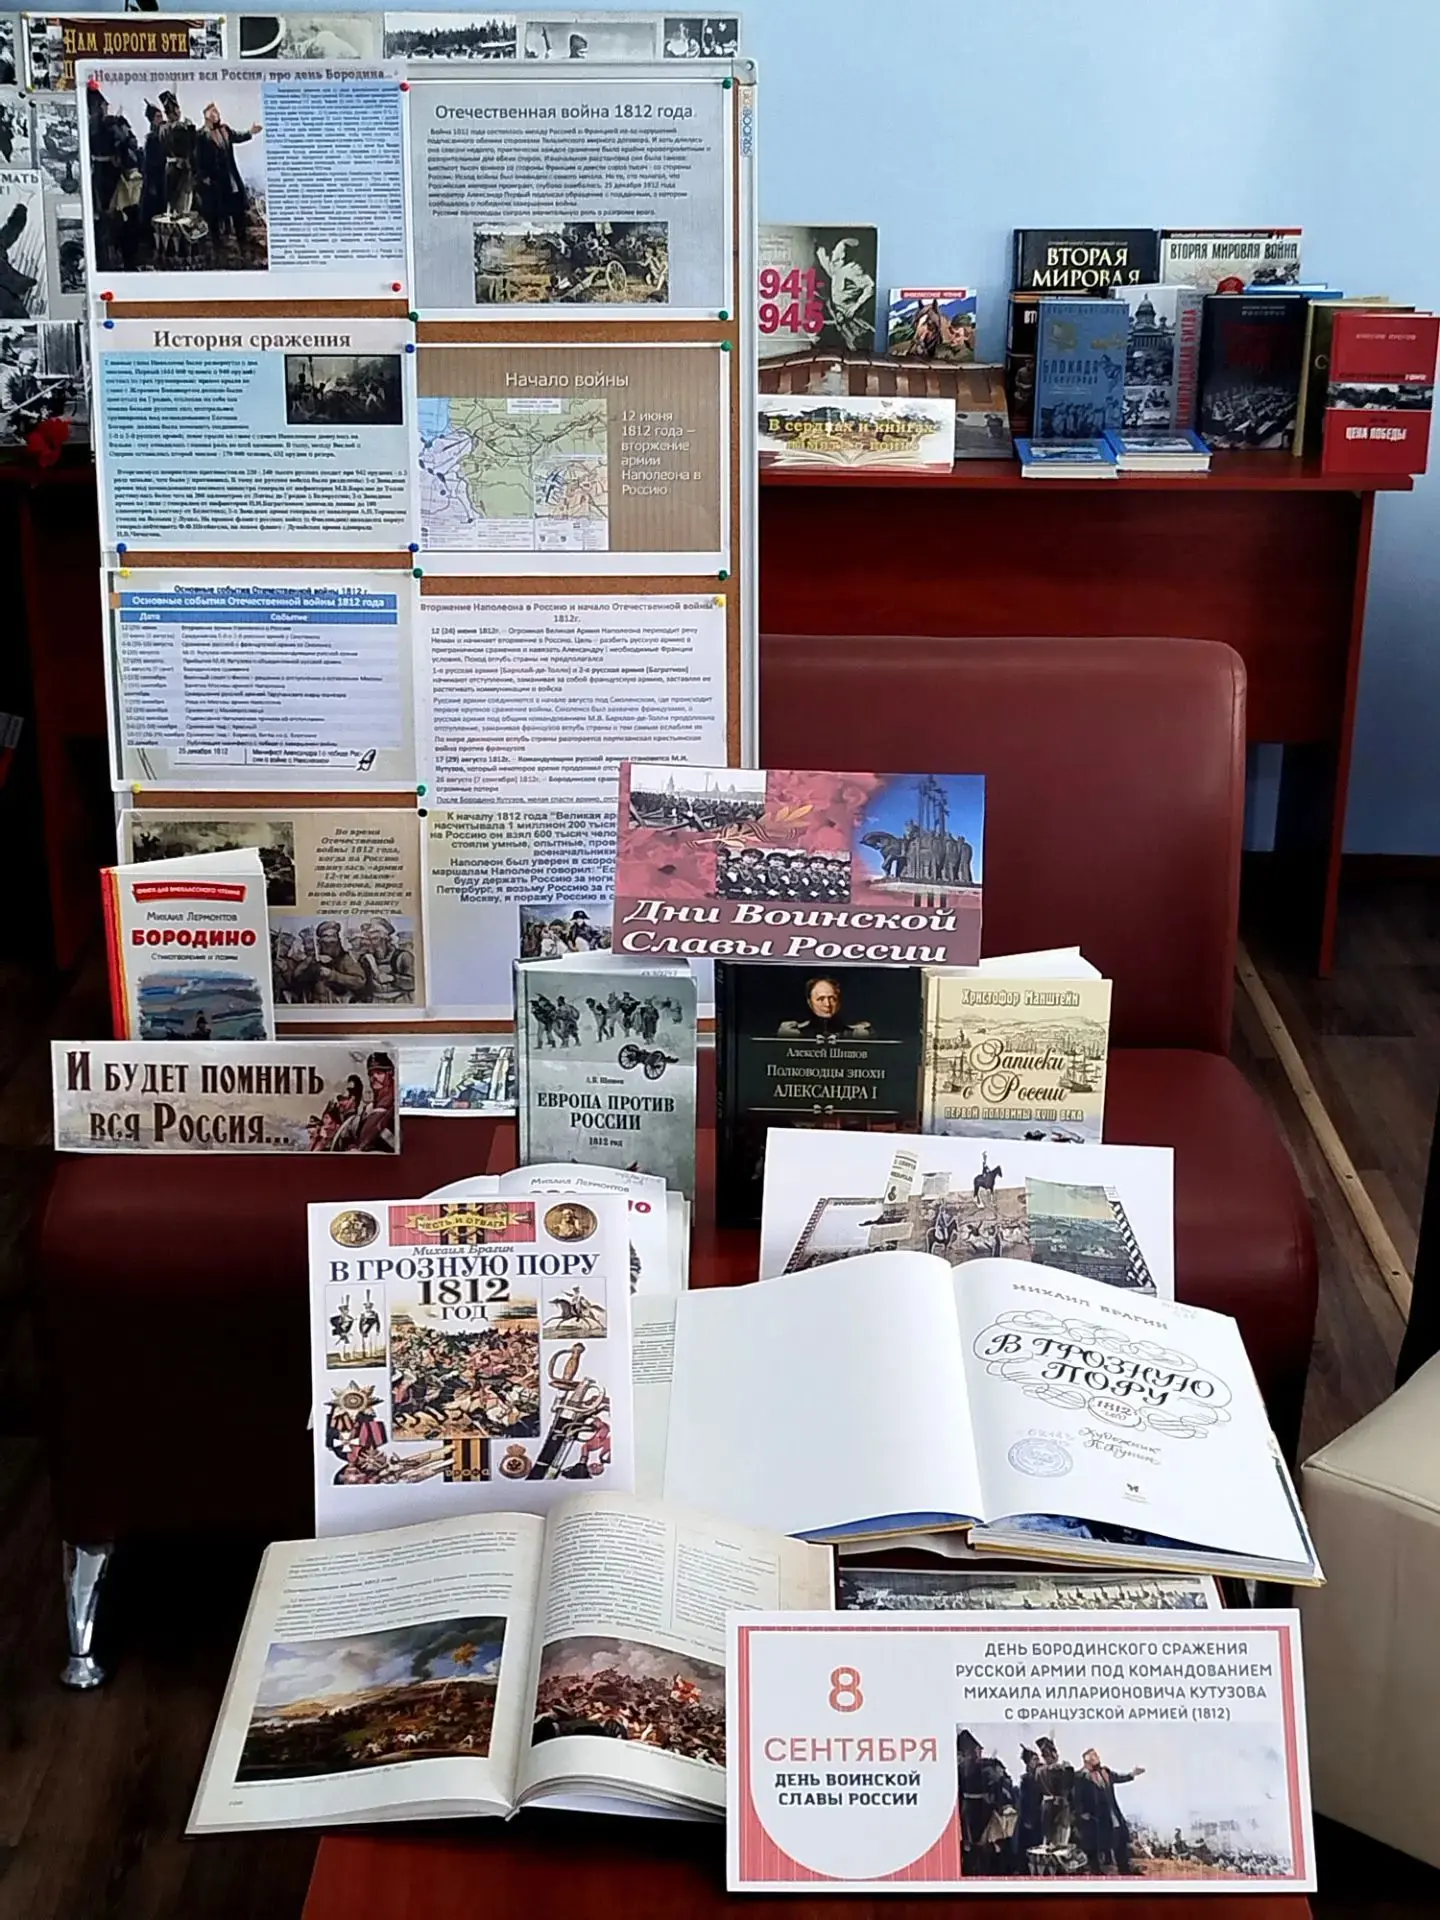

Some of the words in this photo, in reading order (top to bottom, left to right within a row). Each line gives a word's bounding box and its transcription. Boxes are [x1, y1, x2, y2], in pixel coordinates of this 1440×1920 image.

[64, 29, 97, 53] НАМ
[103, 32, 157, 54] ДОРОГИ
[162, 32, 187, 54] ЭТИ
[435, 105, 556, 119] Отечественная
[561, 104, 609, 118] война
[615, 105, 652, 118] 1812
[1047, 248, 1128, 266] ВТОРАЯ
[1170, 243, 1208, 259] ВТОРАЯ
[1212, 243, 1261, 259] МИРОВАЯ
[1265, 241, 1298, 258] ВОЙНА
[1032, 269, 1140, 288] МИРОВАЯ
[153, 331, 243, 351] История
[249, 332, 351, 350] сражения
[505, 372, 568, 387] Начало
[574, 371, 629, 387] войны
[621, 411, 635, 421] 12
[639, 412, 673, 421] июня
[621, 426, 650, 436] 1812
[654, 427, 683, 438] года
[1346, 427, 1368, 440] ЦЕНА
[1369, 427, 1407, 441] ПОБЕДЫ
[621, 442, 689, 452] вторжение
[621, 457, 661, 466] армии
[621, 470, 690, 481] Наполеона
[694, 472, 701, 480] в
[621, 485, 668, 496] Россию
[132, 596, 182, 606] Основные
[184, 596, 226, 607] события
[229, 597, 301, 606] Отечественной
[303, 597, 335, 607] войны
[338, 598, 360, 607] 1812
[362, 599, 385, 608] года
[447, 812, 453, 820] К
[456, 813, 493, 822] началу
[497, 812, 521, 820] 1812
[524, 813, 548, 821] года
[434, 822, 505, 830] насчитывала
[517, 821, 566, 829] миллион
[446, 831, 487, 840] Россию
[506, 831, 531, 839] взял
[534, 830, 552, 838] 600
[450, 858, 503, 867] Наполеон
[506, 858, 529, 866] был
[531, 858, 569, 867] уверен
[432, 868, 488, 877] маршалам
[491, 867, 544, 875] Наполеон
[547, 866, 594, 874] говорил:
[454, 876, 479, 886] буду
[482, 876, 528, 885] держать
[531, 875, 572, 884] Россию
[506, 885, 545, 894] возьму
[548, 884, 589, 893] Россию
[460, 894, 502, 903] Москву,
[514, 894, 554, 902] поражу
[556, 892, 597, 901] Россию
[623, 900, 720, 923] Дни
[731, 903, 957, 932] Воинской
[132, 929, 256, 948] БОРОДИНО
[623, 931, 773, 956] Славы
[784, 936, 947, 962] России
[961, 989, 1020, 1007] Христофор
[1024, 990, 1080, 1007] Манштейн
[786, 1048, 827, 1058] Алексей
[829, 1049, 868, 1059] Шишов
[969, 1038, 1066, 1072] Записки
[66, 1051, 91, 1092] И
[104, 1062, 189, 1094] БУДЕТ
[200, 1064, 324, 1095] ПОМНИТЬ
[767, 1064, 844, 1079] Полководцы
[847, 1068, 885, 1079] эпохи
[773, 1084, 868, 1100] АЛЕКСАНДРА
[871, 1086, 877, 1099] I
[963, 1086, 973, 1099] о
[981, 1070, 1068, 1103] России
[537, 1092, 601, 1109] ЕВРОПА
[608, 1095, 675, 1112] ПРОТИВ
[570, 1112, 641, 1130] РОССИИ
[944, 1106, 980, 1120] ПЕРВОЙ
[982, 1107, 1032, 1120] ПОЛОВИНЫ
[1035, 1108, 1057, 1121] XVIII
[1060, 1109, 1084, 1121] ВЕКА
[90, 1113, 141, 1143] ВСЯ
[589, 1137, 608, 1146] 1812
[418, 1218, 451, 1229] ЧЕСТЬ
[466, 1217, 506, 1228] ОТВАГА
[412, 1246, 465, 1256] Михаил
[467, 1245, 514, 1255] Брагин
[329, 1261, 350, 1282] В
[356, 1256, 509, 1281] ГРОЗНУЮ
[516, 1254, 601, 1276] ПОРУ
[418, 1278, 510, 1306] 1812
[985, 1333, 1022, 1356] В
[1032, 1337, 1215, 1399] ГРОЗНУЮ
[1041, 1361, 1169, 1406] ПОРУ
[1097, 1400, 1132, 1416] 1812
[985, 1643, 1028, 1657] ДЕНЬ
[1032, 1643, 1158, 1657] БОРОДИНСКОГО
[1162, 1643, 1248, 1656] СРАЖЕНИЯ
[956, 1662, 1026, 1678] РУССКОЙ
[1031, 1665, 1087, 1677] АРМИИ
[1091, 1665, 1124, 1679] ПОД
[1129, 1664, 1272, 1679] КОМАНДОВАНИЕМ
[829, 1666, 864, 1712] 8
[964, 1686, 1041, 1699] МИХАИЛА
[1046, 1686, 1186, 1700] ИЛЛАРИОНОВИЧА
[1190, 1686, 1267, 1699] КУТУЗОВА
[1005, 1708, 1013, 1720] С
[1017, 1705, 1124, 1721] ФРАНЦУЗСКОЙ
[1128, 1705, 1188, 1720] АРМИЕЙ
[1192, 1707, 1230, 1721] (1812)
[764, 1738, 937, 1762] СЕНТЯБРЯ
[774, 1773, 820, 1788] ДЕНЬ
[826, 1770, 921, 1786] ВОИНСКОЙ
[778, 1793, 842, 1805] СЛАВЫ
[849, 1793, 918, 1805] РОССИИ
